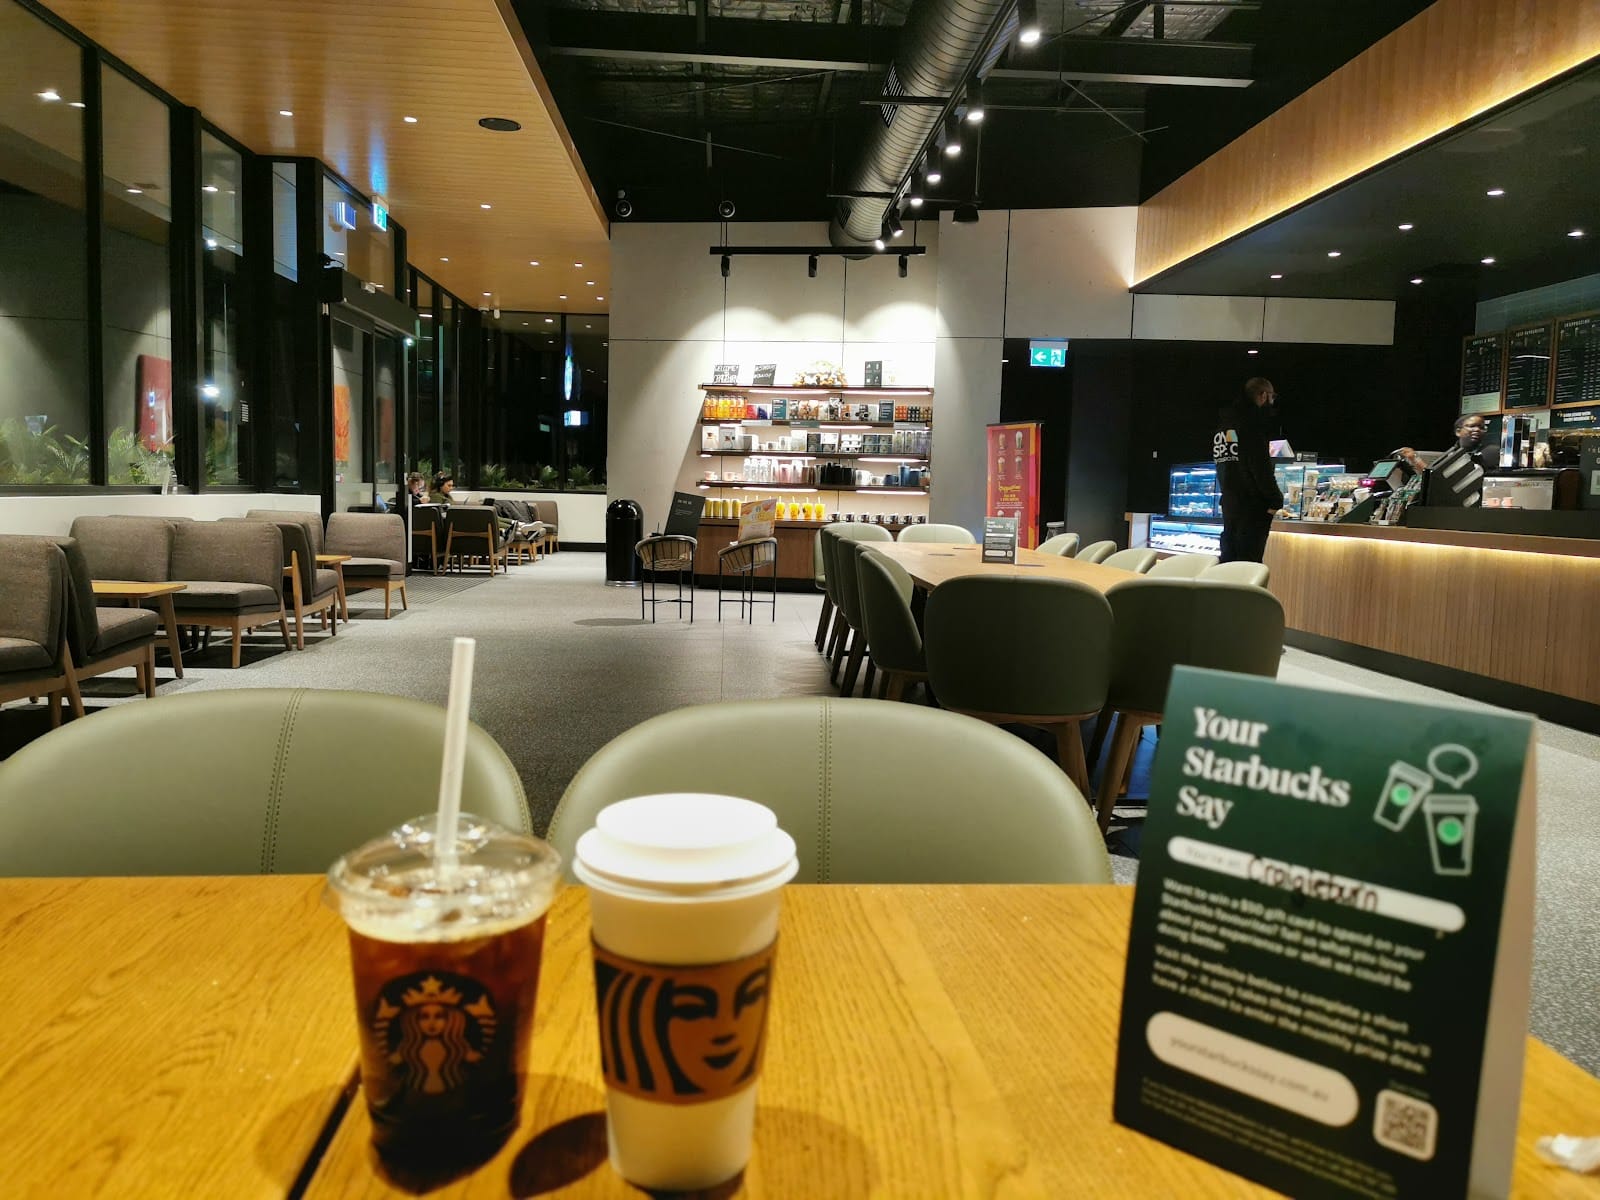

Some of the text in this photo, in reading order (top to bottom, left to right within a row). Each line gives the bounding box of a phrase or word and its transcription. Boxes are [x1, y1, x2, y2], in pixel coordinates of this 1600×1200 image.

[1193, 706, 1269, 748] Your
[1182, 746, 1351, 807] Starbucks
[1175, 784, 1235, 829] Say
